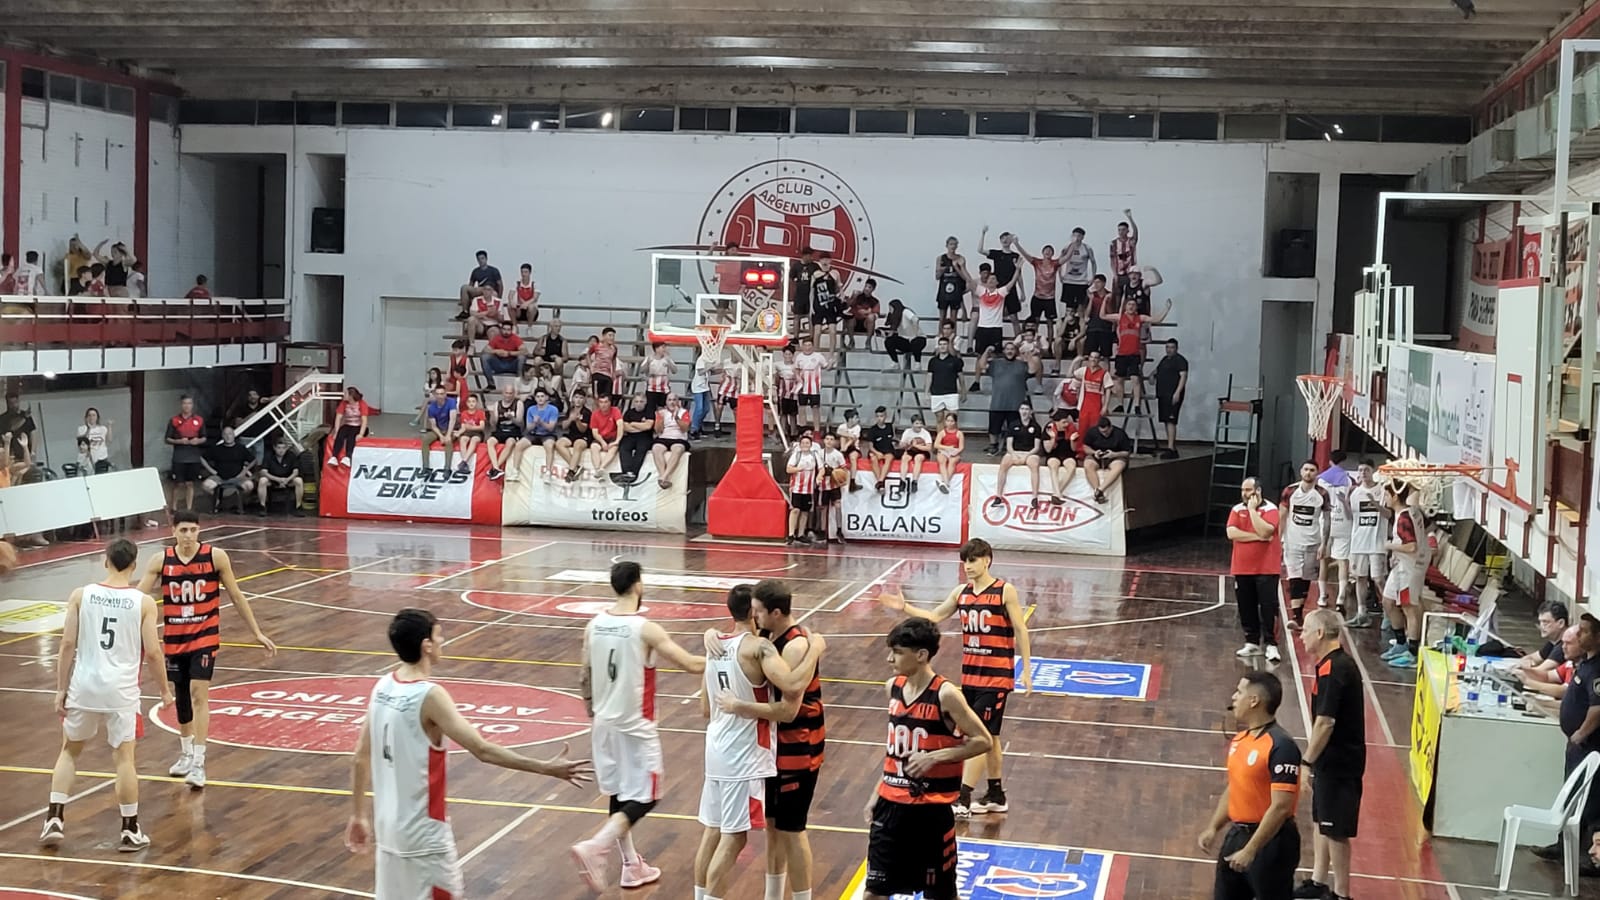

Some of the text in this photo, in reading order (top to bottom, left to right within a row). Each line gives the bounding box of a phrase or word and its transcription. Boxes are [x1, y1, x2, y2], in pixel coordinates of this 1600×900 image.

[758, 189, 831, 214] ARGENTINO
[776, 183, 813, 197] CLUB
[376, 482, 442, 500] BIKE
[592, 508, 649, 522] trofeos
[847, 513, 942, 534] BALANS
[169, 579, 207, 603] CAC
[961, 609, 993, 633] CAC
[100, 617, 118, 650] 5
[607, 648, 618, 682] 6
